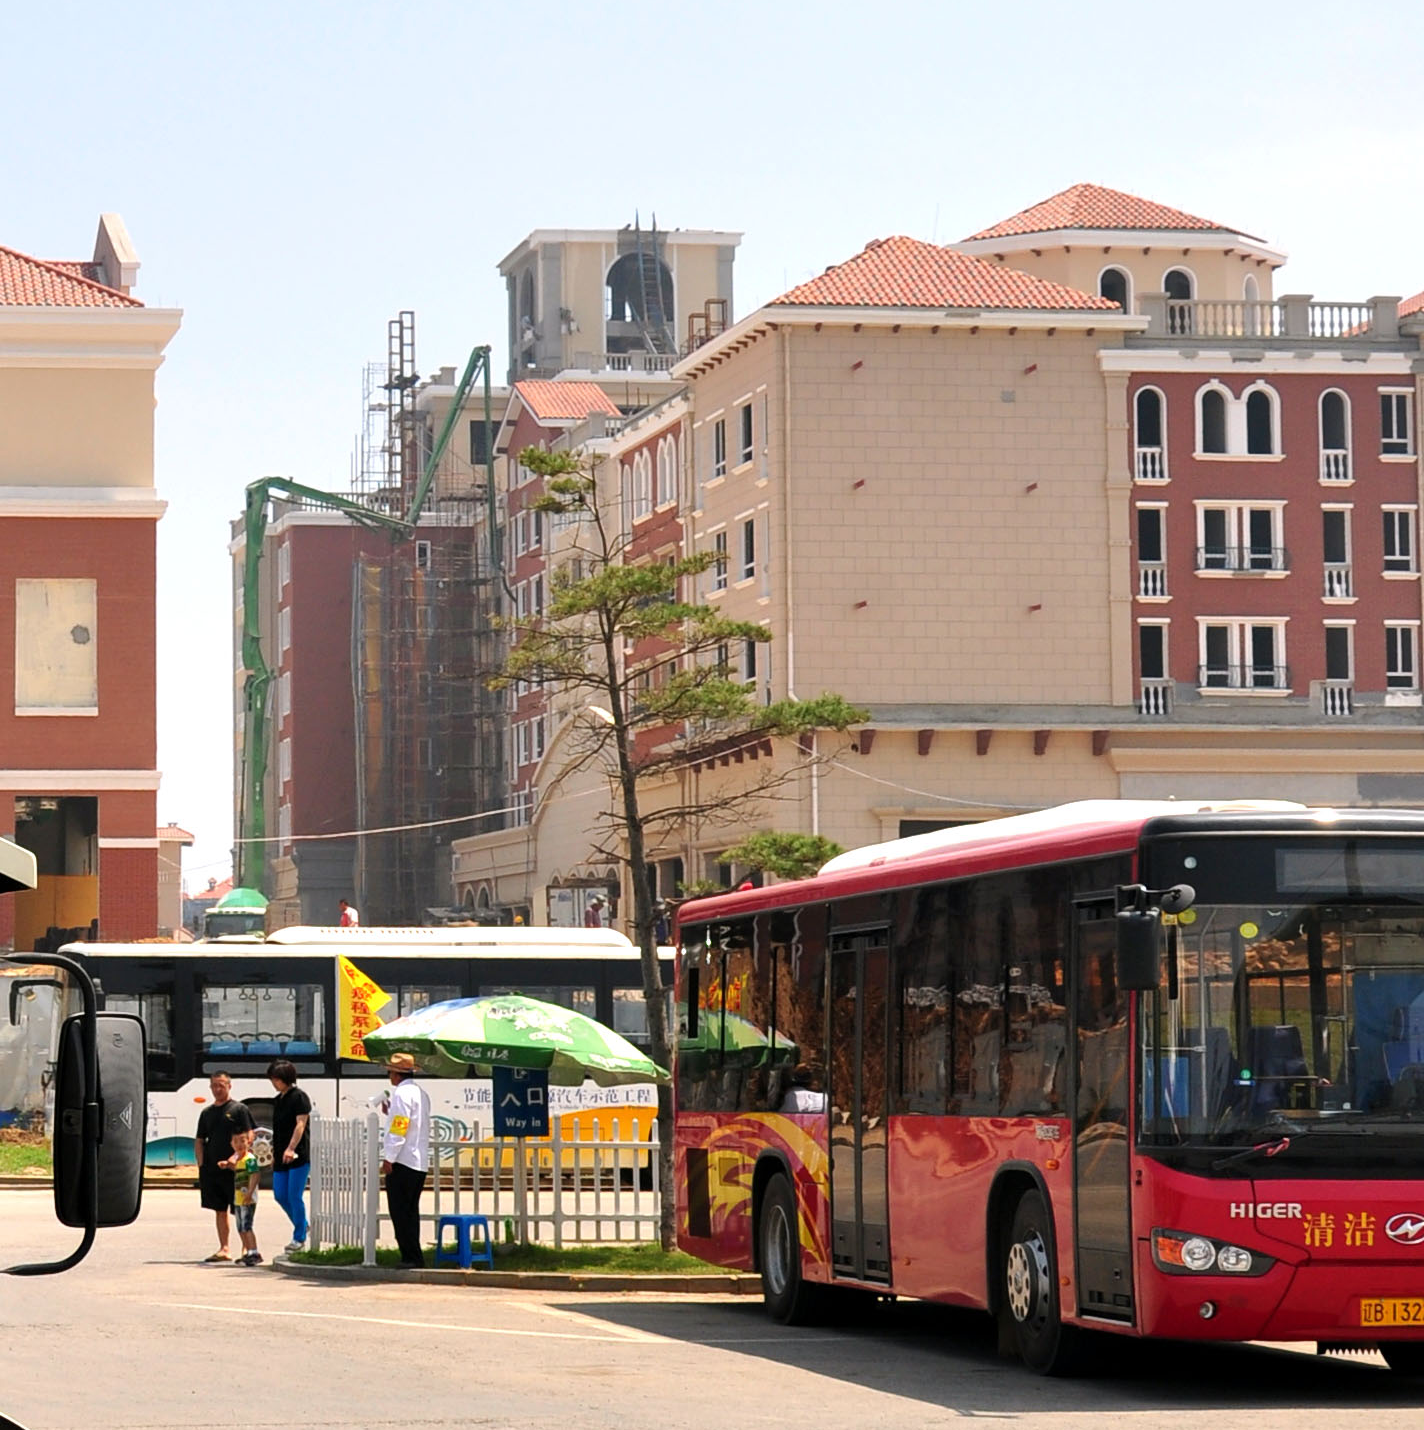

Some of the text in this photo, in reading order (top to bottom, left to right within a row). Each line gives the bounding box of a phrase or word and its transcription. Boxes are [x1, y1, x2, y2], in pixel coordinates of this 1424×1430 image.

[501, 1087, 544, 1108] 入口
[505, 1117, 541, 1129] Way in
[1230, 1202, 1302, 1219] HIGER
[1303, 1212, 1376, 1247] 清洁
[1363, 1302, 1424, 1323] 辽B·132
